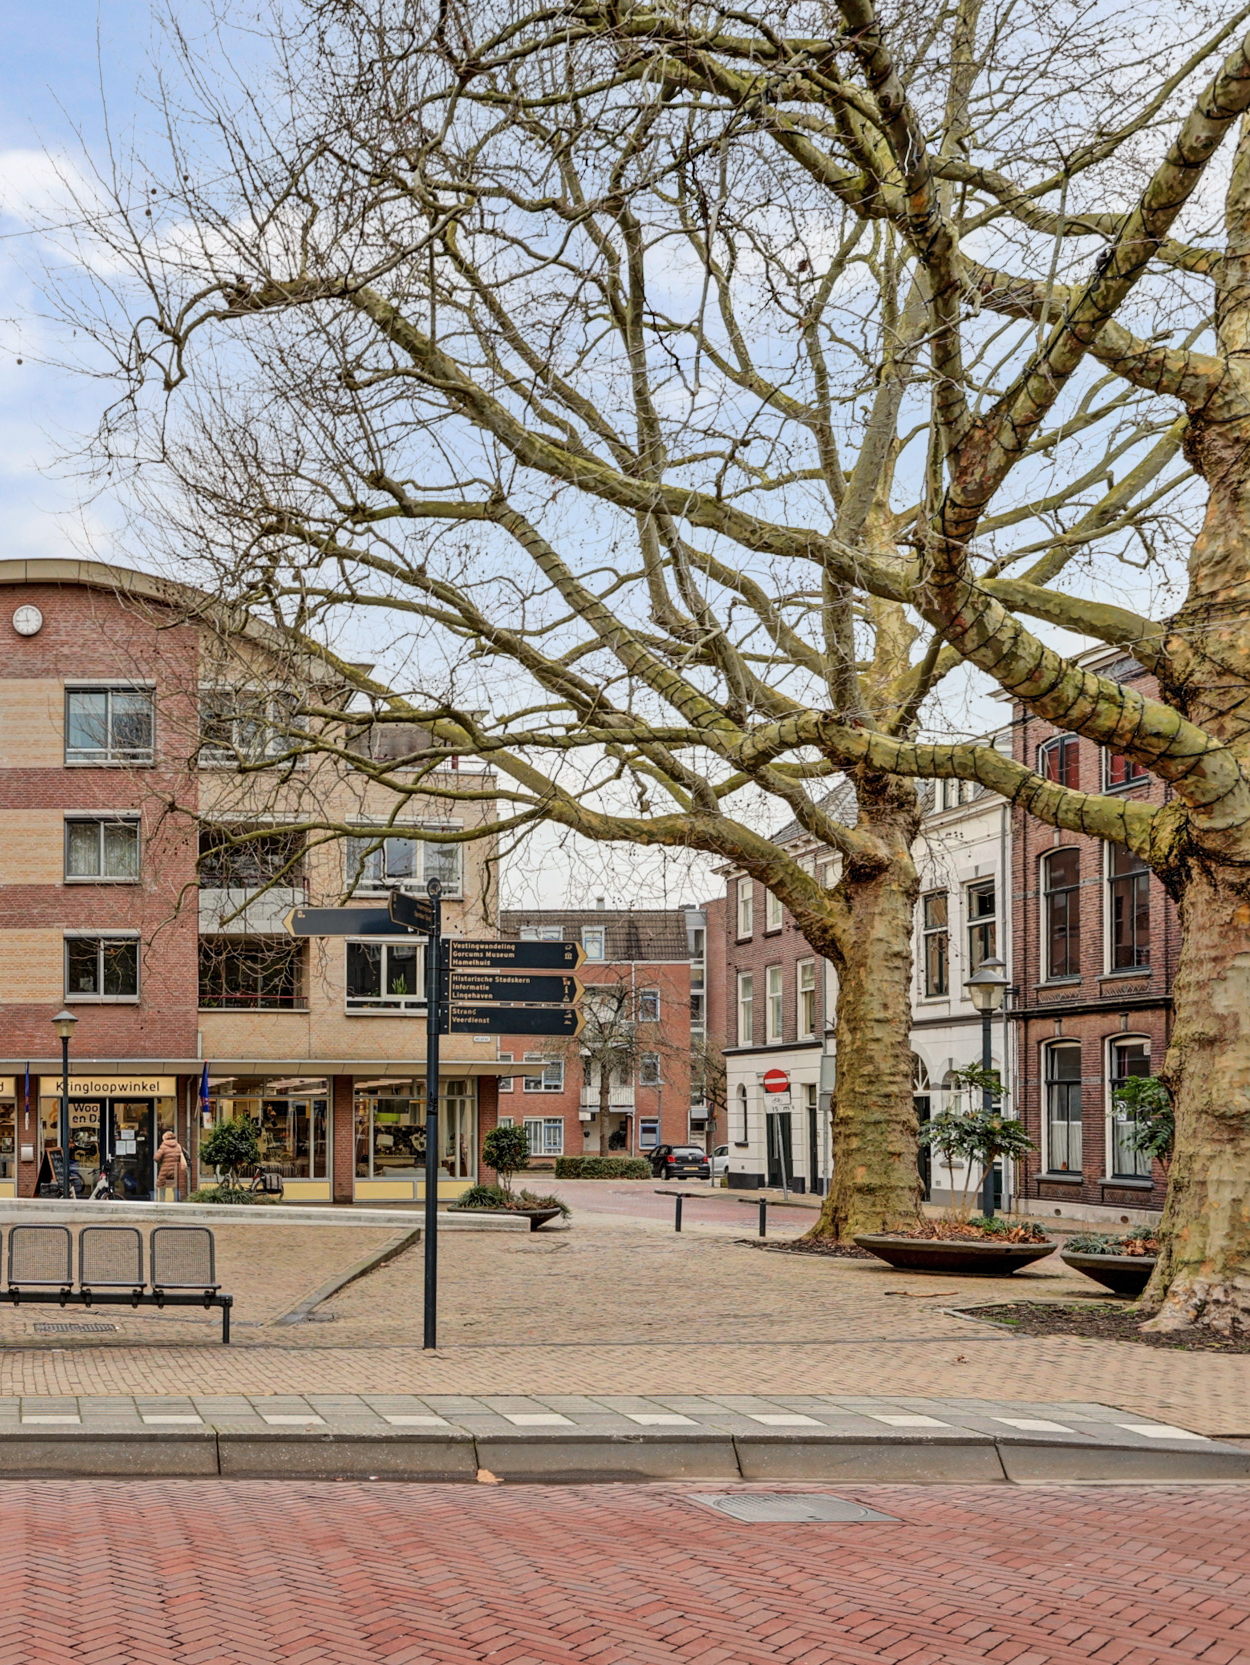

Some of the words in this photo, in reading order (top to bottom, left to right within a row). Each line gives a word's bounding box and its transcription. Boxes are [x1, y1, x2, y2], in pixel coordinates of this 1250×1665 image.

[452, 943, 515, 951] Vestingwandeling
[56, 1081, 160, 1094] Kingloopwinkel
[73, 1103, 99, 1112] Woo
[72, 1115, 86, 1123] en
